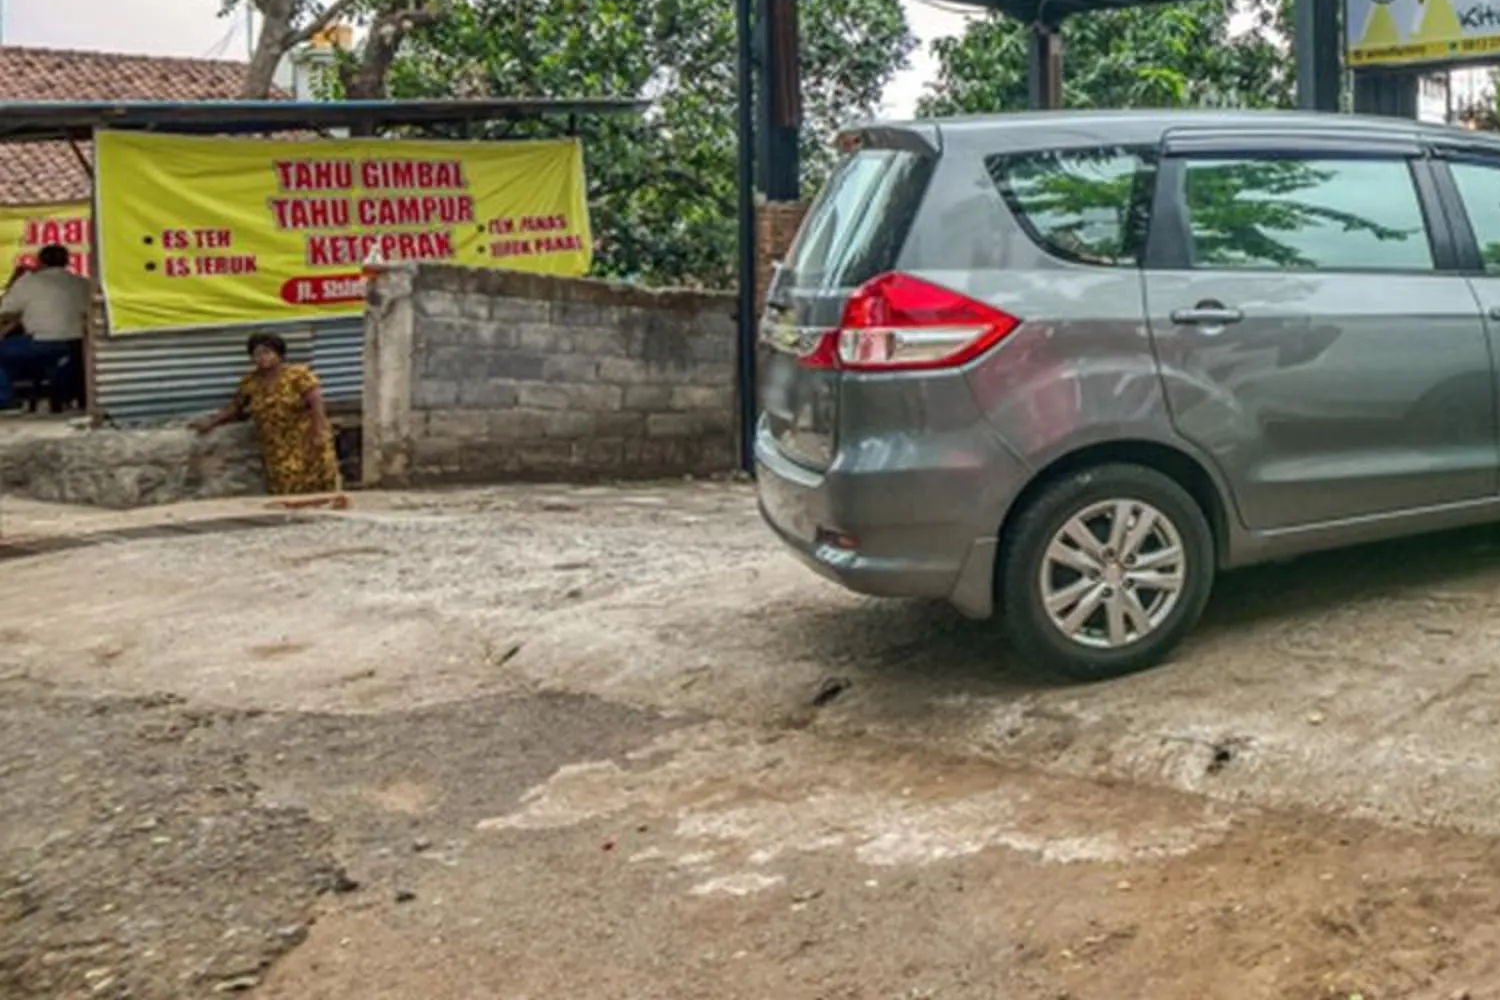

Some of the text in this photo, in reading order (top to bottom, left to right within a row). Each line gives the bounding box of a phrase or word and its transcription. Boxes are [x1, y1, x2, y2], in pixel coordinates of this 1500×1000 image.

[275, 160, 466, 190] TAHU GIMBAL
[271, 196, 475, 228] TAHU CAMPUR
[162, 229, 231, 250] ES TEH
[164, 256, 191, 277] ES
